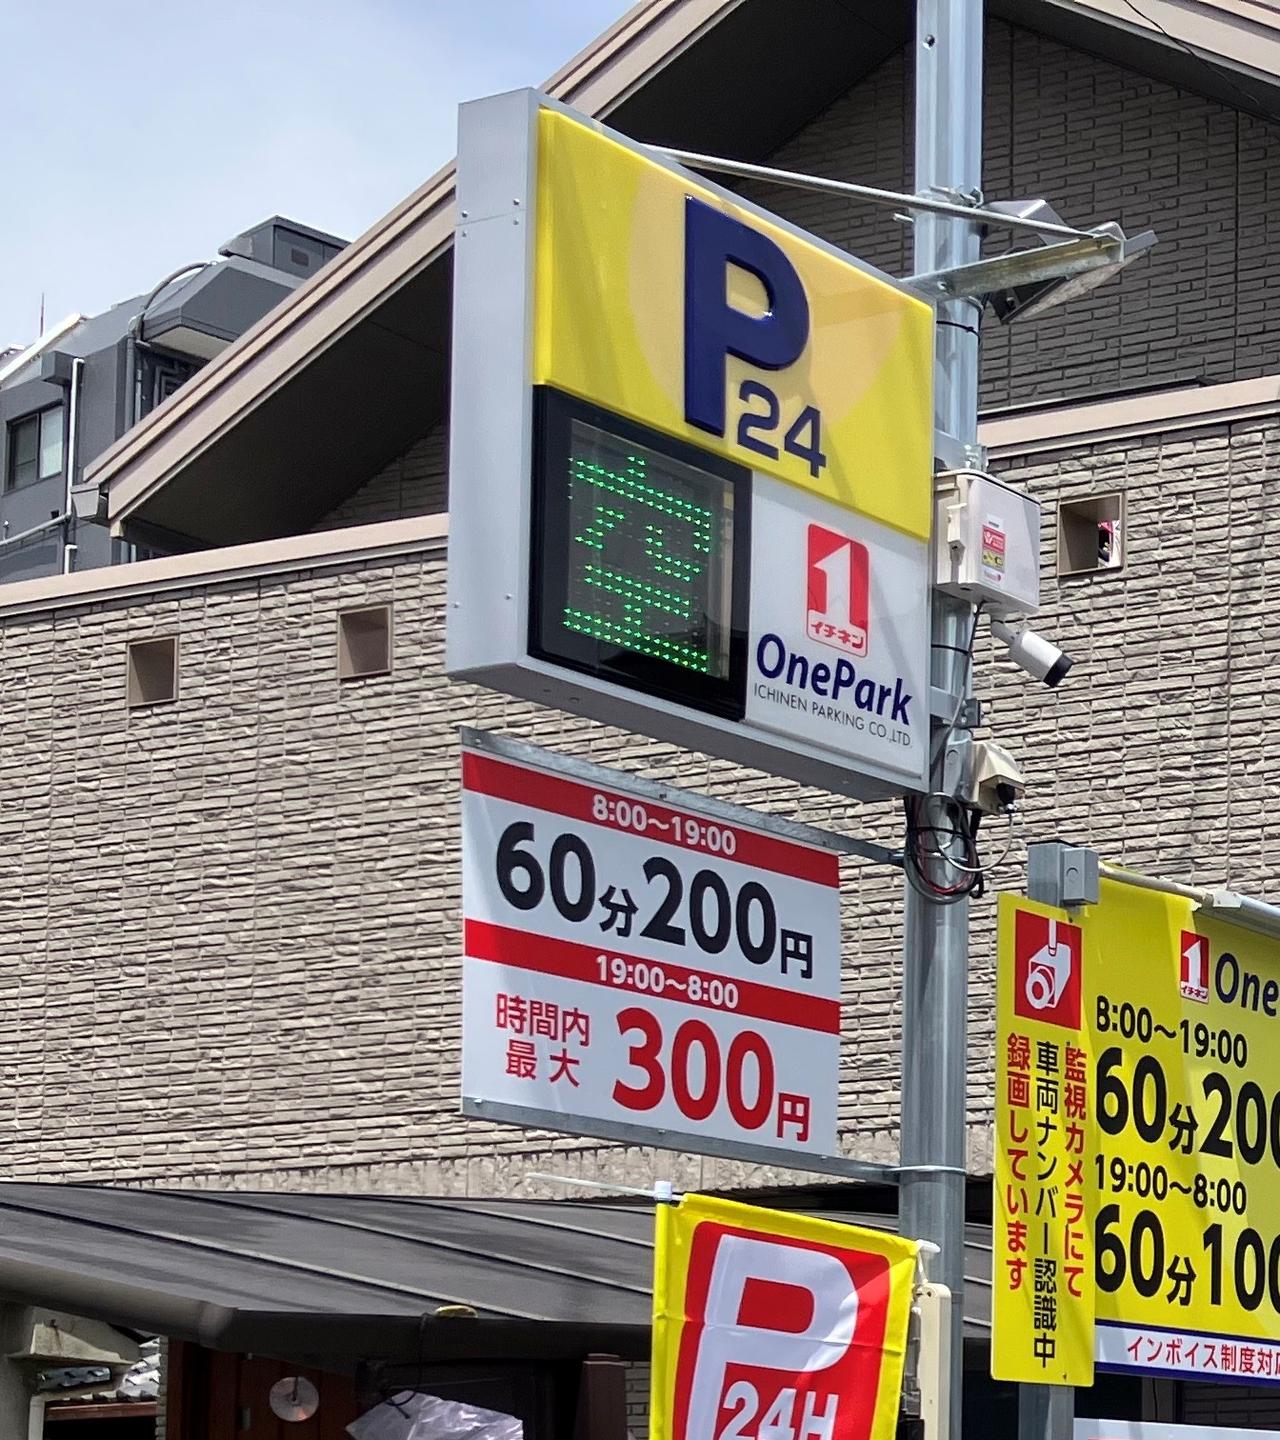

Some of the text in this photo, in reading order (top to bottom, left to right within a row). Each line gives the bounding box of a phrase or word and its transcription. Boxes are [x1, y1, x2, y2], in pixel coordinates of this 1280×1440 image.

[684, 193, 810, 437] P
[737, 381, 826, 478] 24
[563, 455, 712, 673] 空
[756, 633, 913, 726] OnePark
[811, 621, 864, 649] イチネン
[754, 682, 808, 712] ICHINEN
[812, 702, 865, 730] PARKING
[496, 820, 814, 980] 60分200円
[495, 993, 592, 1048] 時間内
[505, 1039, 581, 1088] 最大
[611, 1006, 812, 1143] 300円
[1006, 1031, 1031, 1292] 録画しています
[1033, 1040, 1060, 1369] 車両ナンバー認識中
[1064, 1046, 1087, 1299] 監視カメラにて
